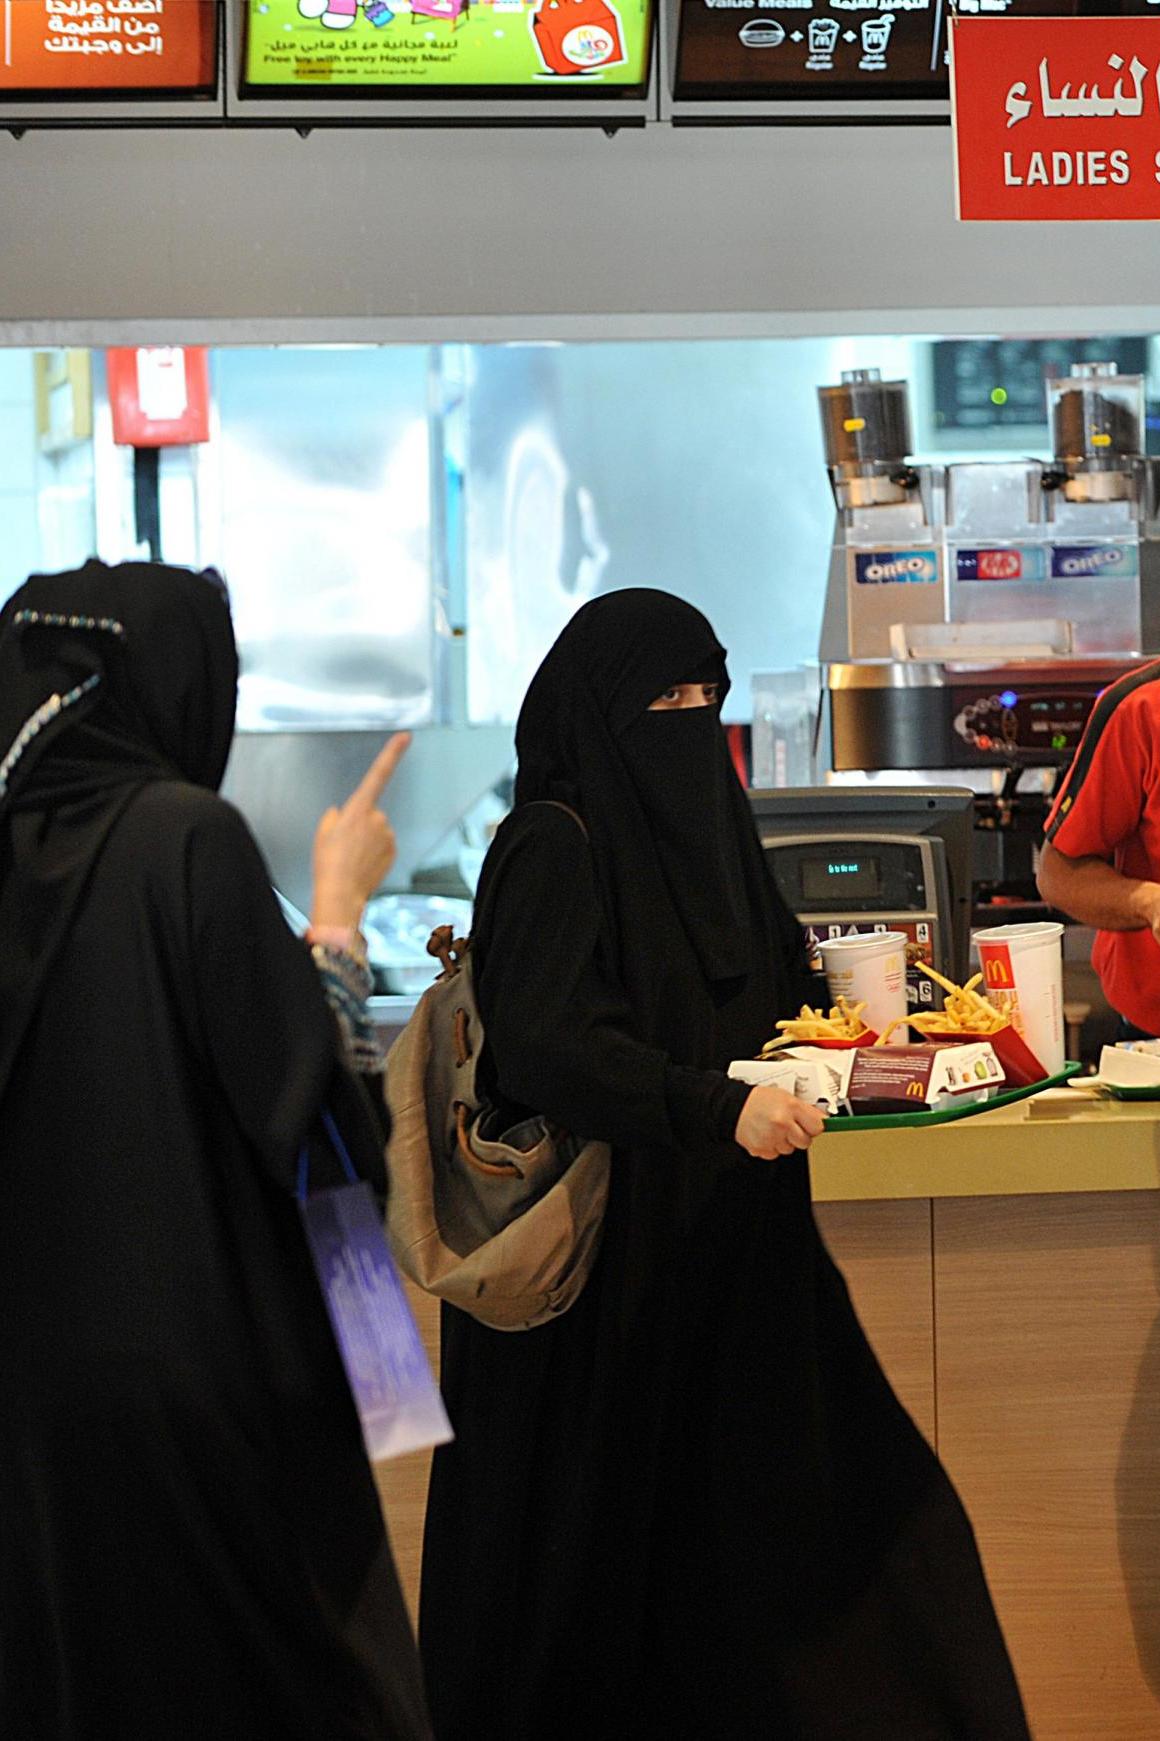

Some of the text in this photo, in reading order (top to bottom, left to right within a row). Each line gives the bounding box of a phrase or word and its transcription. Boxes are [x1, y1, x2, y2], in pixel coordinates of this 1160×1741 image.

[48, 15, 160, 35] من القيمة
[44, 36, 123, 55] وجبتك
[1004, 149, 1130, 186] LADIES
